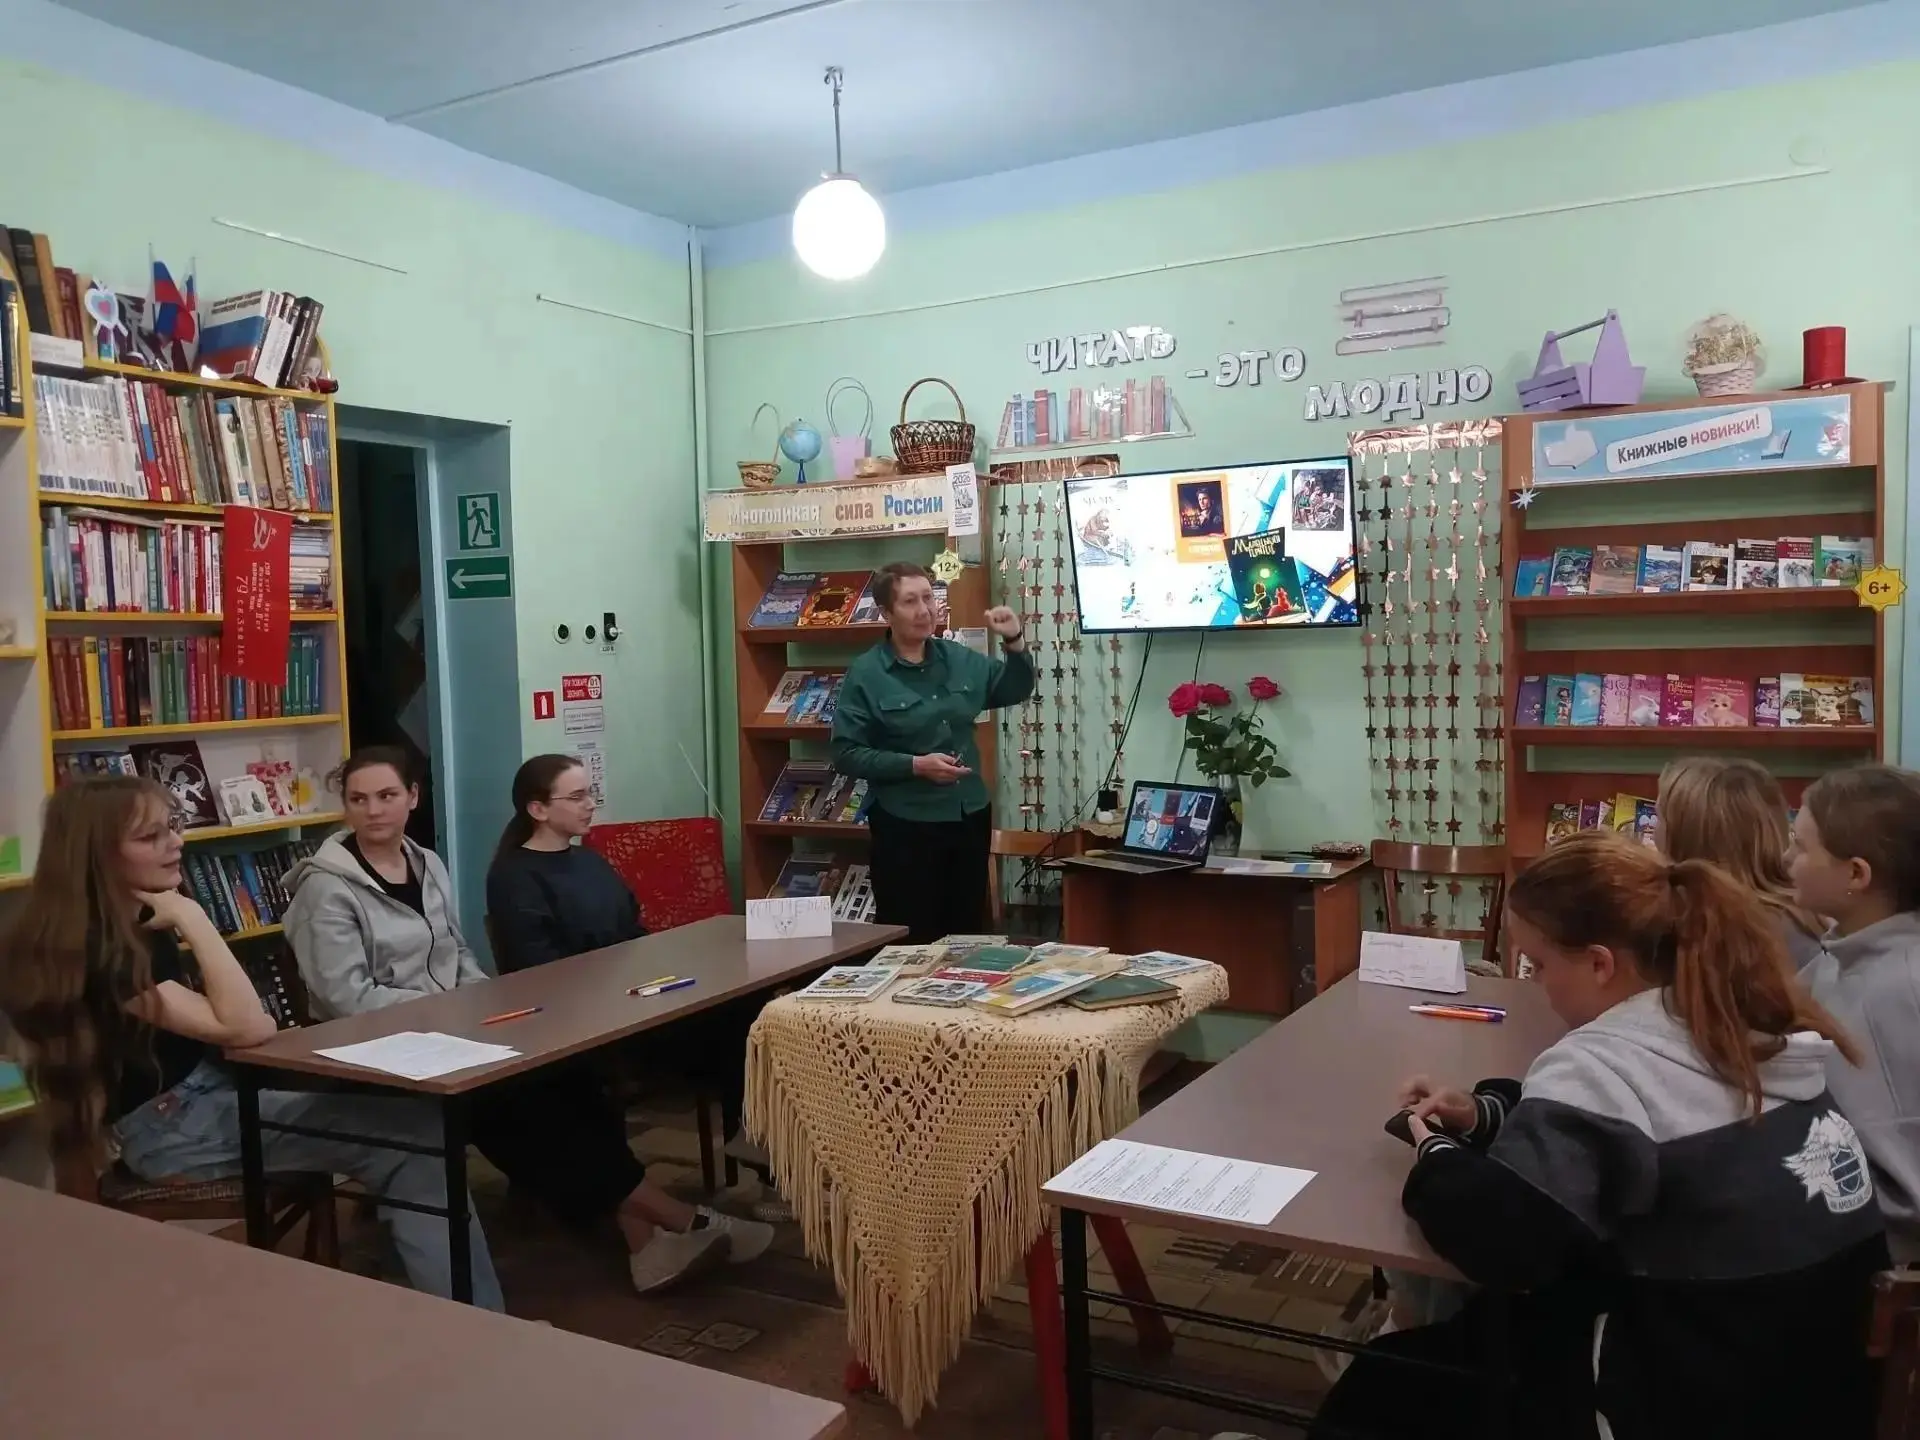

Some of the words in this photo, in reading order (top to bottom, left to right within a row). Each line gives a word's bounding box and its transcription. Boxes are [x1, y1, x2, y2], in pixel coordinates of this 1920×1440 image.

[1025, 325, 1177, 373] ЧИТАТЬ
[1302, 364, 1493, 422] МОДНО
[1617, 433, 1688, 465] Книжные
[1690, 414, 1761, 446] новинки!
[728, 503, 820, 526] Многоликая
[834, 500, 874, 522] сила
[884, 494, 944, 518] России
[938, 561, 959, 572] 12+
[236, 575, 249, 594] 79
[1868, 581, 1892, 595] 6+
[589, 678, 598, 686] 01
